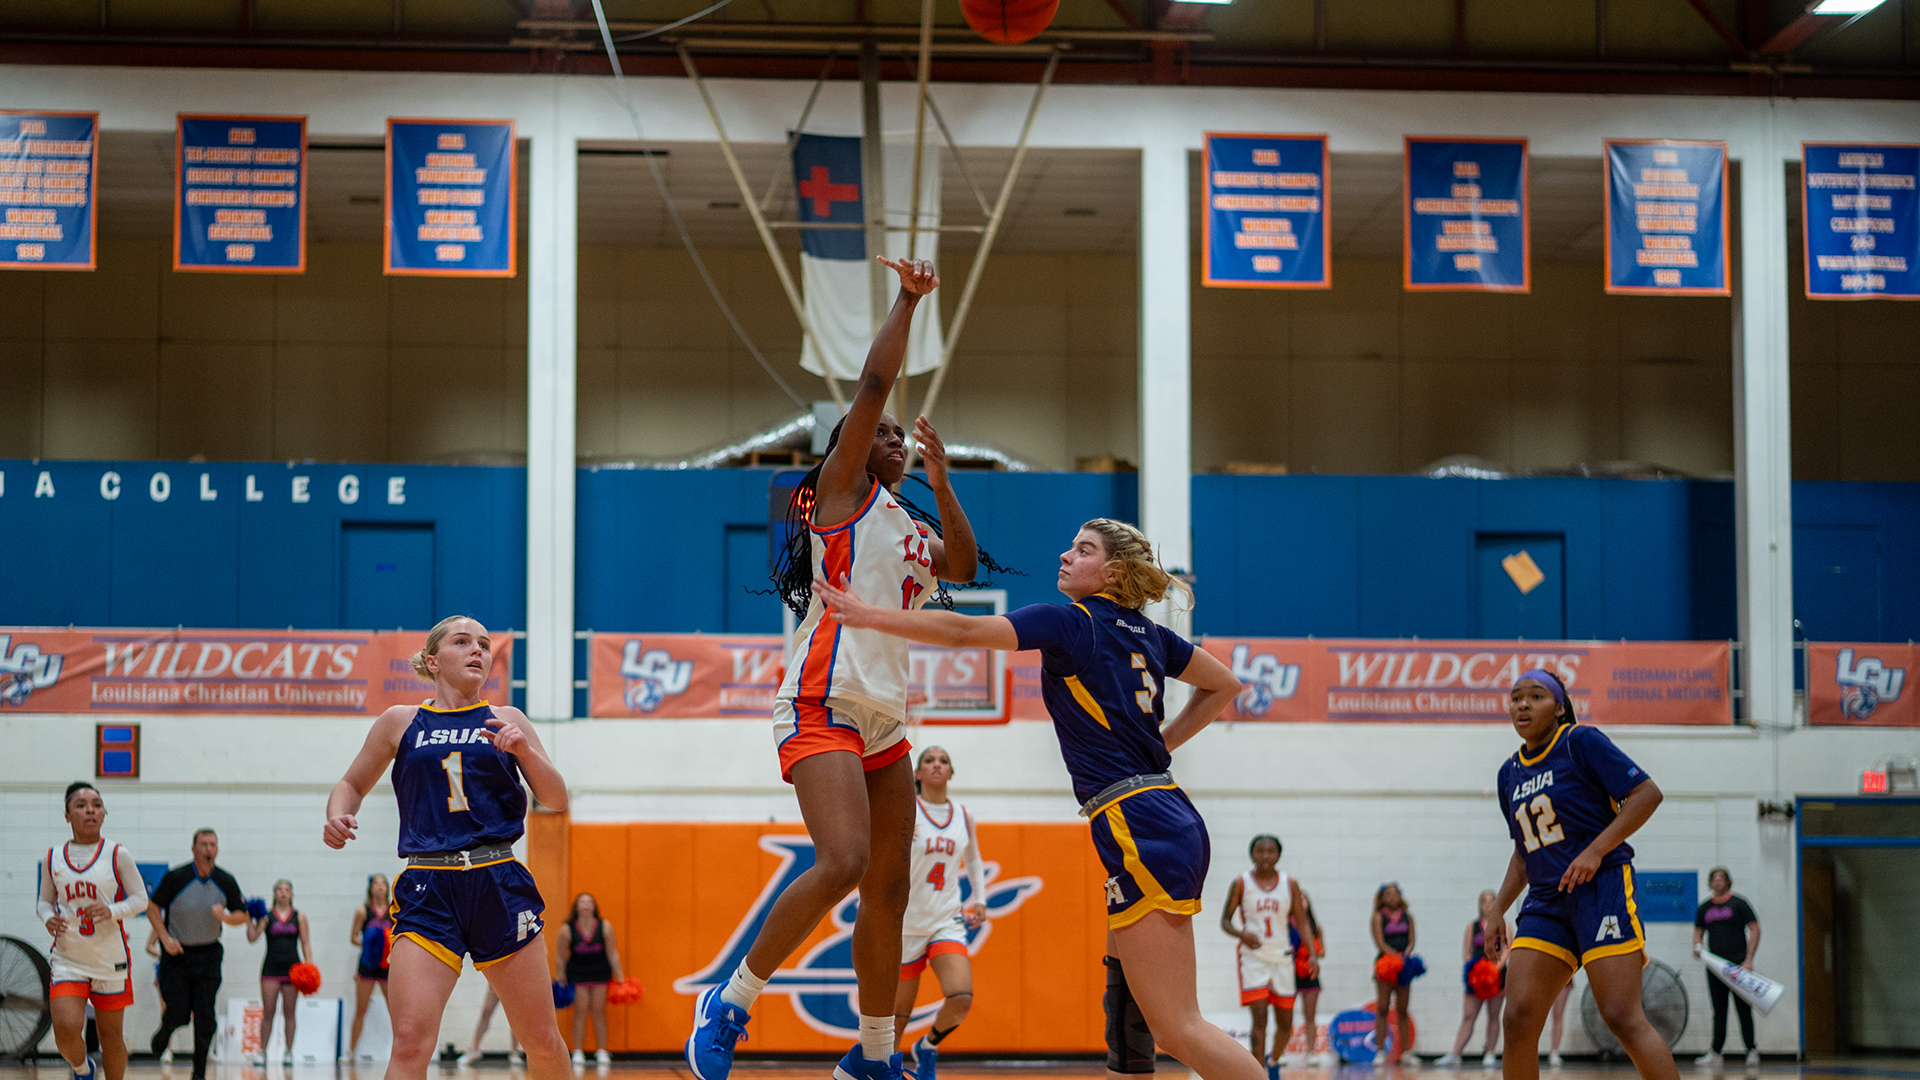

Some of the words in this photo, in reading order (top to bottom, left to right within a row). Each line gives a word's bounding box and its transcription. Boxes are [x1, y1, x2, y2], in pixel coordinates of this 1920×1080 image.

[100, 475, 406, 504] COLLEGE
[104, 642, 359, 680] WILDCATS
[620, 639, 694, 695] LCU
[1230, 644, 1301, 698] LCU
[1337, 652, 1582, 689] WILDCATS
[1836, 647, 1906, 703] LCU
[91, 682, 180, 701] Louisiana
[184, 682, 270, 703] Christian
[274, 683, 367, 709] University
[1130, 652, 1158, 714] 3
[1328, 692, 1411, 711] Louisiana
[1415, 692, 1502, 714] Christian
[415, 728, 491, 748] LSUA
[442, 751, 470, 813] 1
[1512, 769, 1554, 802] LSUA
[1515, 793, 1565, 854] 12
[925, 836, 956, 856] LCU
[65, 880, 97, 903] LCU
[926, 862, 945, 891] 4
[77, 907, 95, 937] 3
[1264, 917, 1272, 938] 1
